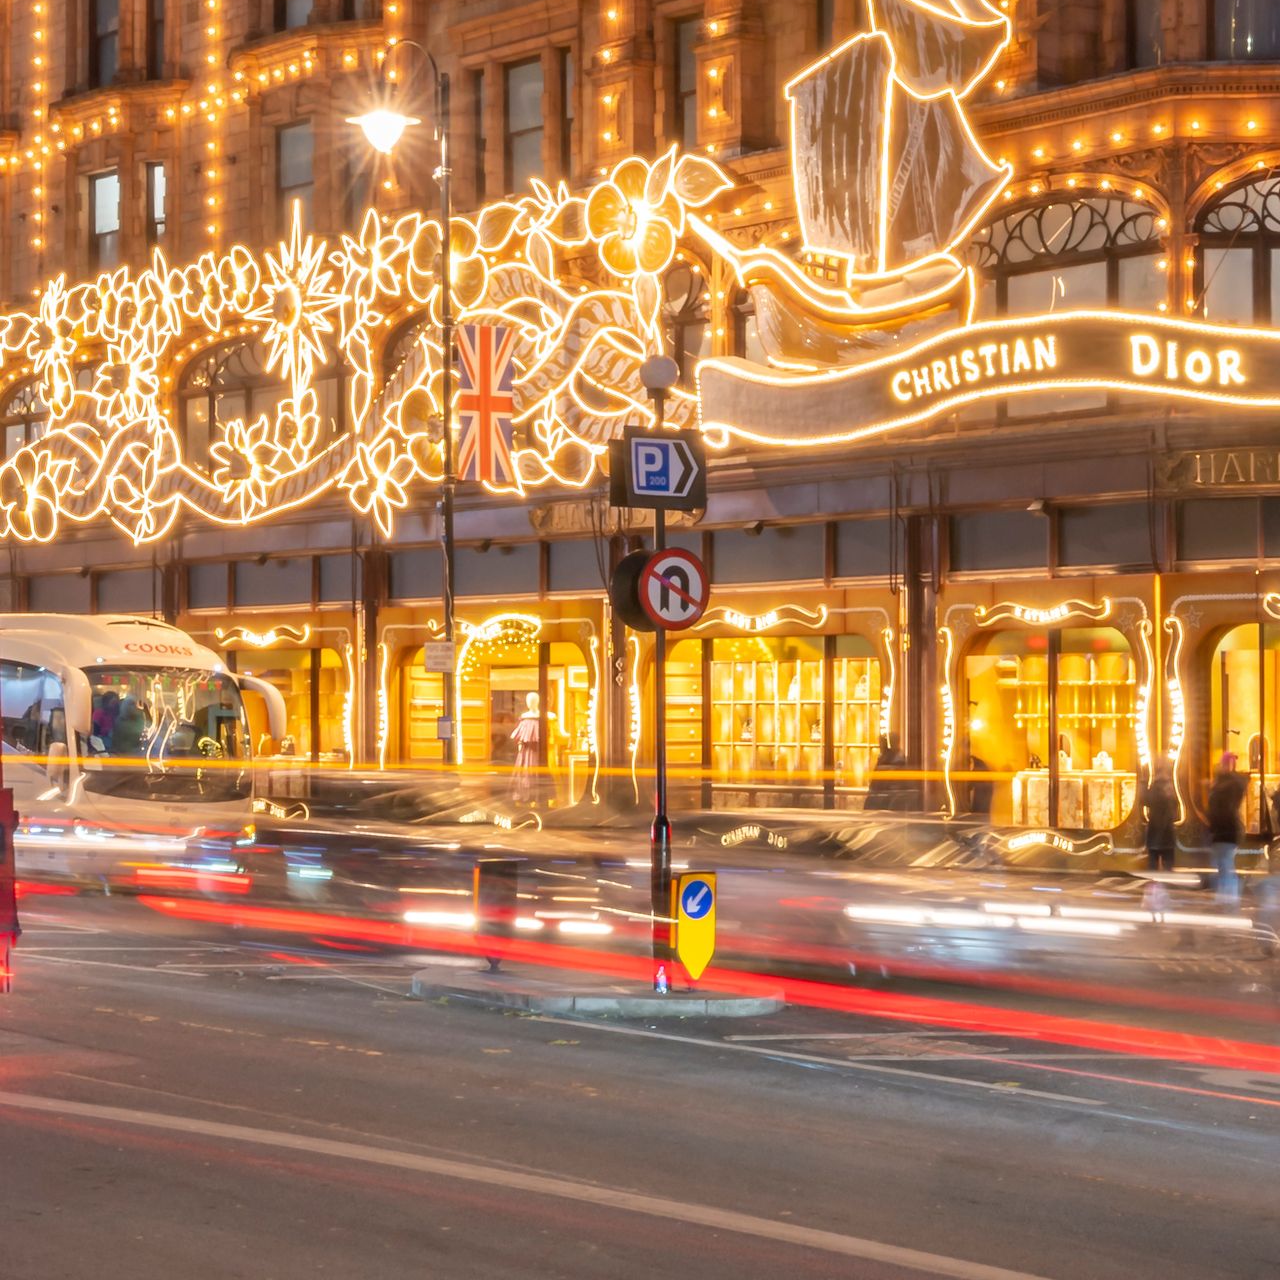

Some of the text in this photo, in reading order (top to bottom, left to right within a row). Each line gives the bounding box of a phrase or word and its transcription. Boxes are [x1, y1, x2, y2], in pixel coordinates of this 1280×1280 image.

[890, 334, 1246, 402] CHRISTIAN DIOR
[638, 446, 663, 486] P
[124, 643, 193, 656] COOKS
